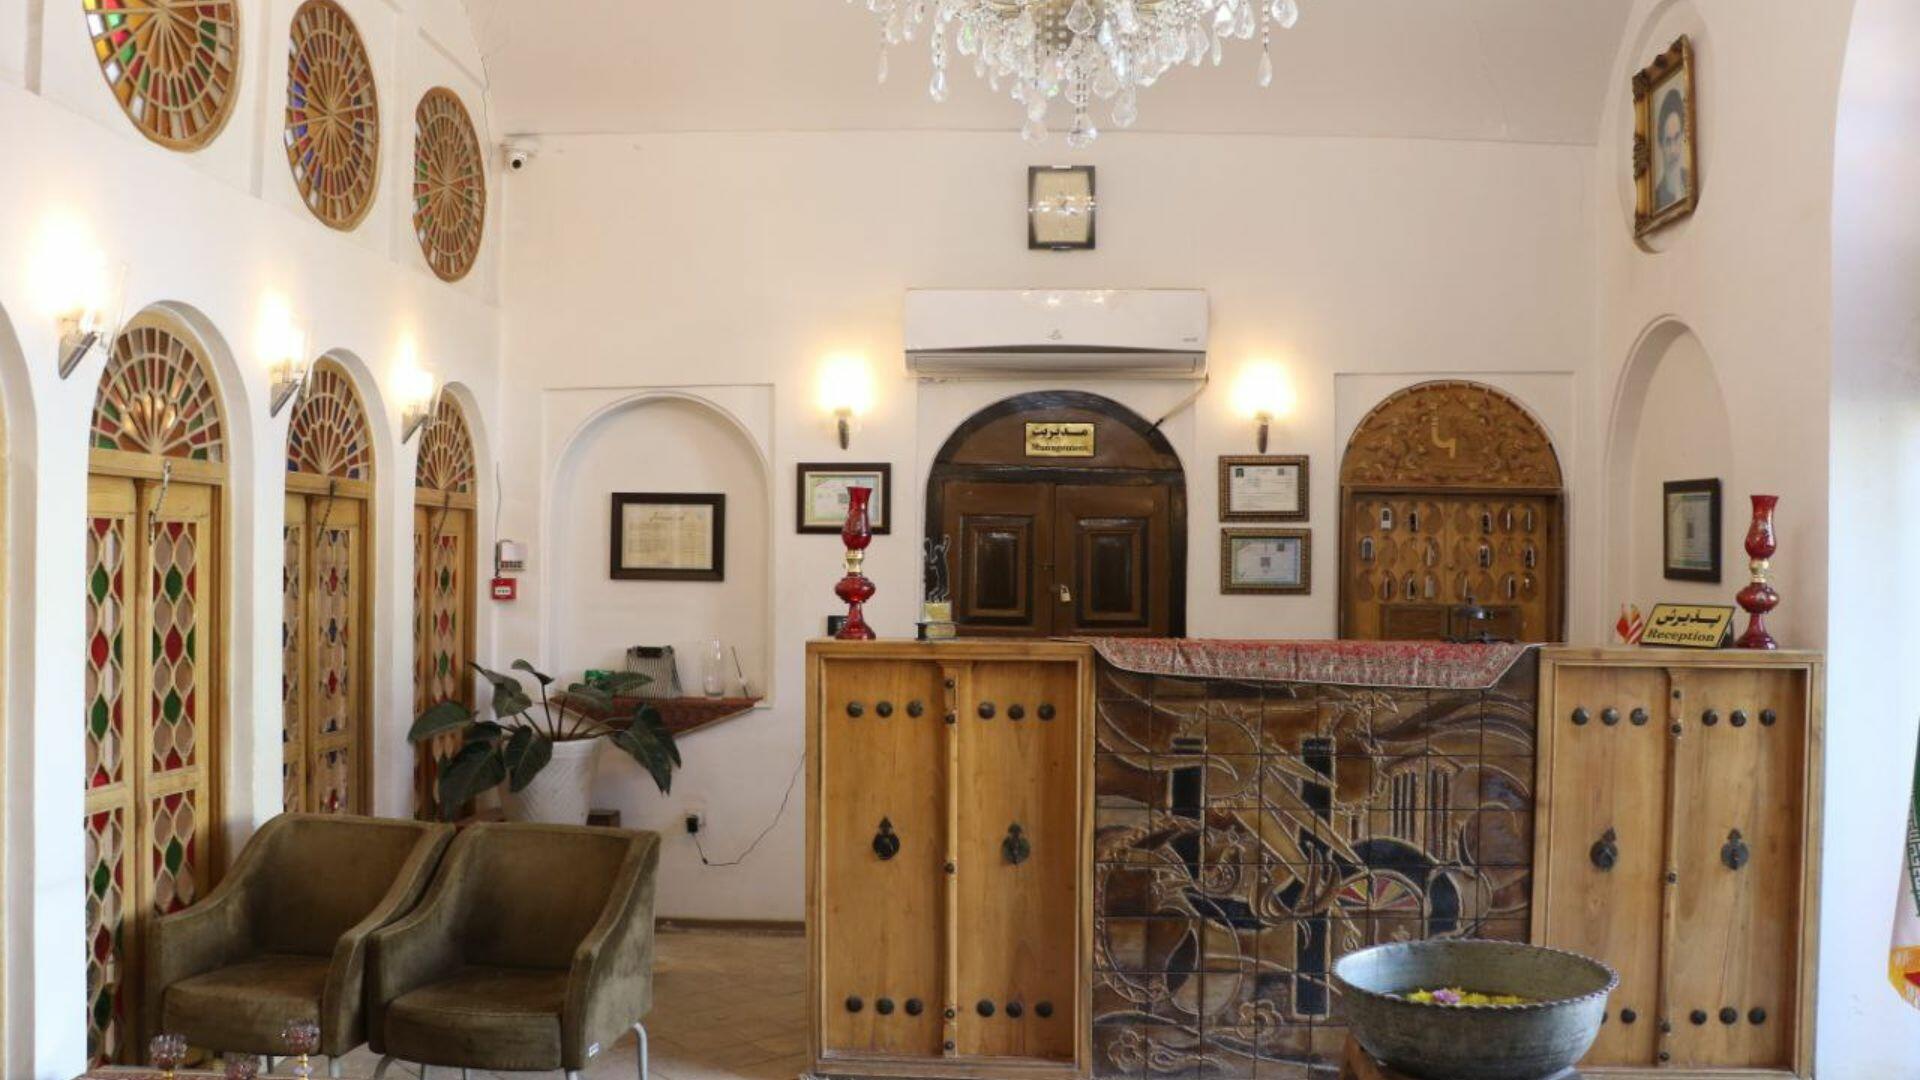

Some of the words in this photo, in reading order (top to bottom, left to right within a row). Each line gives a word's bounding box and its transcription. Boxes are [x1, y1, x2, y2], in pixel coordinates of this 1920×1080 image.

[1031, 427, 1088, 440] مدیریت
[1656, 608, 1721, 628] پذیرش
[1647, 628, 1716, 642] Reception
